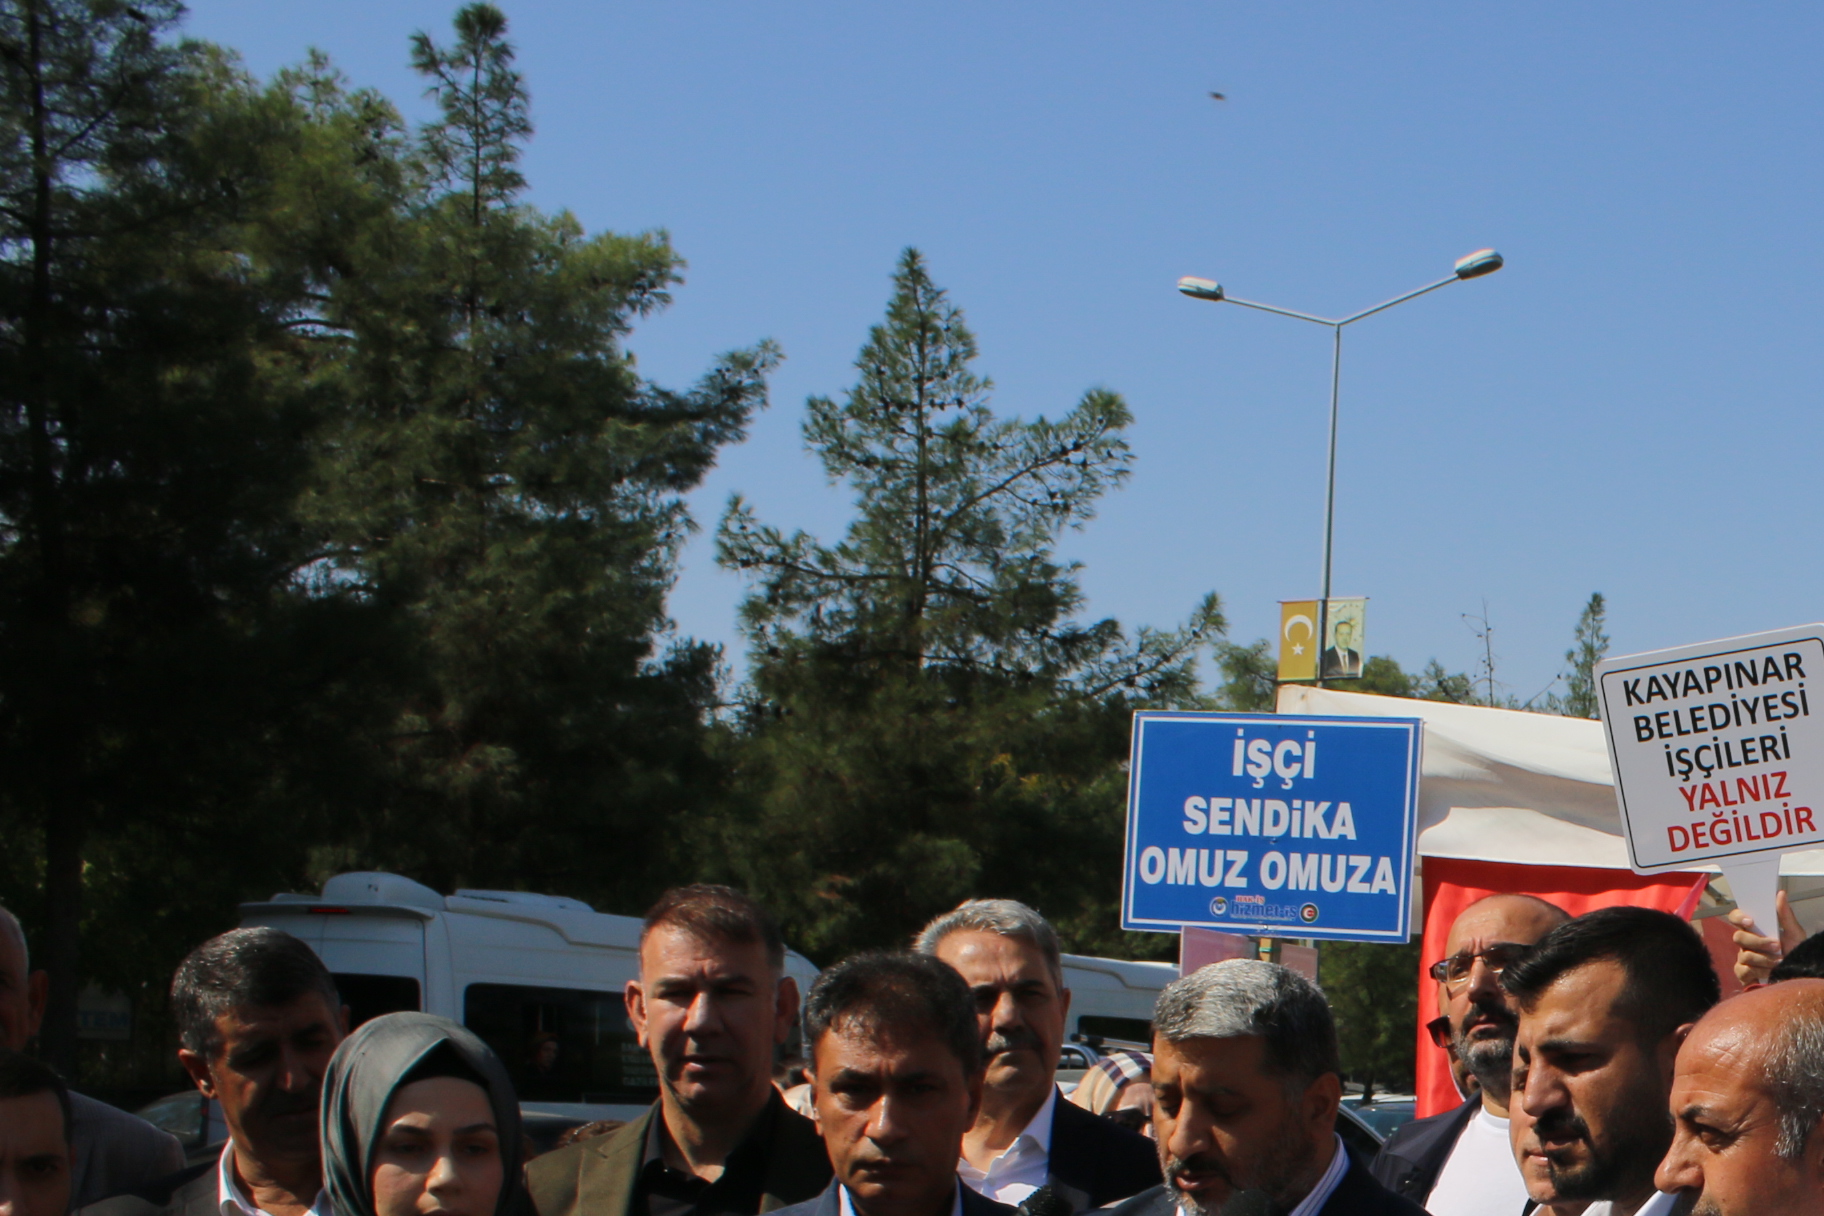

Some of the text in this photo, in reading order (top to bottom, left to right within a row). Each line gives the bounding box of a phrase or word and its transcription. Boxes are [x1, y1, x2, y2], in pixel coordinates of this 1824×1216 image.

[1623, 652, 1806, 707] KAYAPINAR
[1633, 682, 1809, 742] BELEDİYESİ
[1232, 728, 1316, 789] İŞÇİ
[1664, 725, 1791, 782] İŞÇİLERİ
[1679, 771, 1791, 812] YALNIZ
[1667, 802, 1817, 852] DEĞİLDİR
[1139, 846, 1397, 895] OMUZ OMUZA
